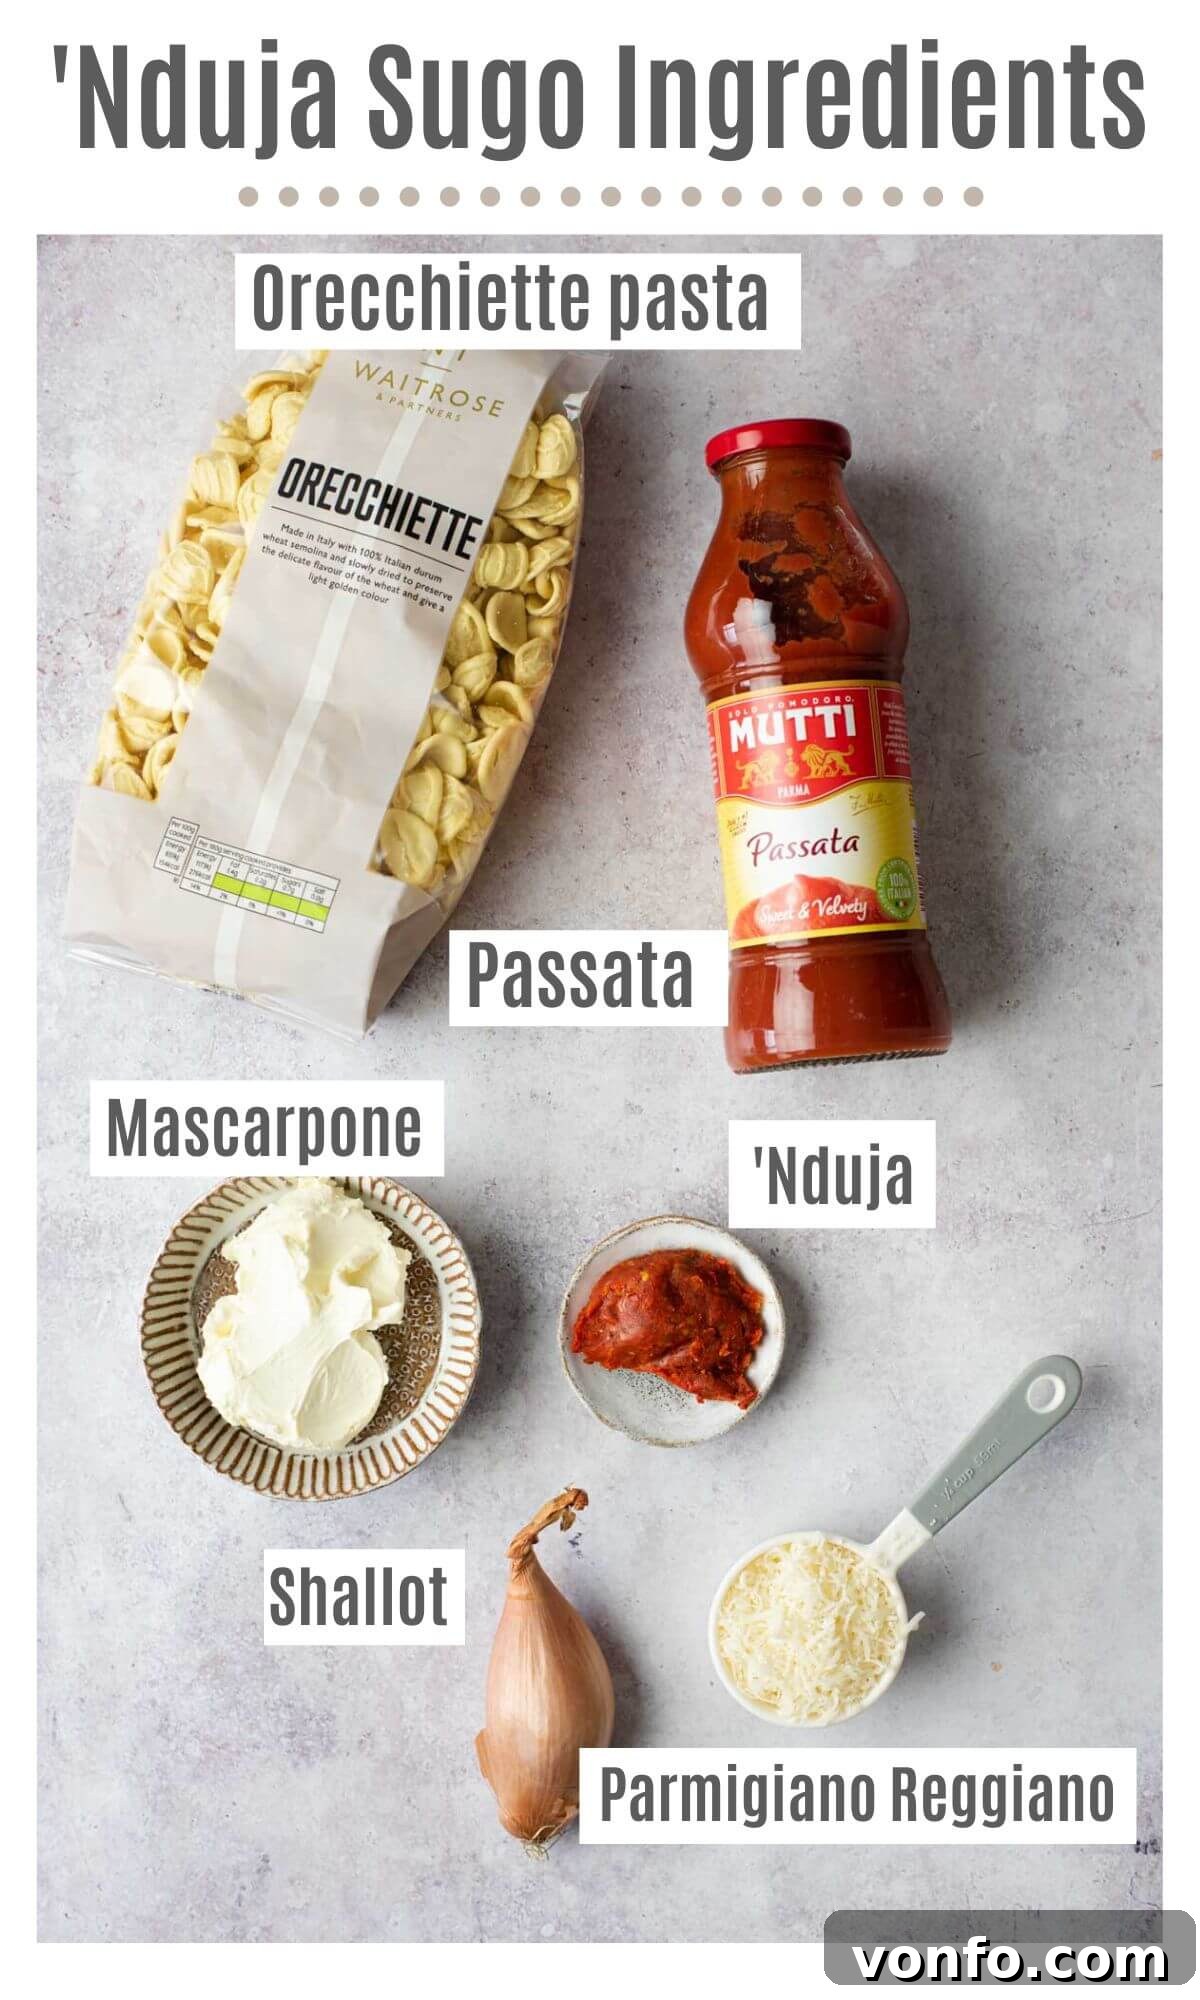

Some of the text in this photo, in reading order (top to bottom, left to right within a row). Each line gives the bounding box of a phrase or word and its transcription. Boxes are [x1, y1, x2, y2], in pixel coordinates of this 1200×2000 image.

[355, 360, 505, 417] WAITROSE
[389, 396, 462, 422] PARTNERS
[277, 457, 483, 560] ORECCHIETTE
[263, 533, 453, 601] wheat semolina and slowly dried to preserve
[281, 523, 442, 583] Made in Italy with 100% Italian durum
[262, 545, 276, 556] the
[278, 550, 311, 566] delicate
[313, 560, 343, 576] flavour
[345, 571, 355, 580] of
[357, 575, 371, 585] the
[374, 580, 400, 594] wheat
[402, 590, 419, 601] and
[419, 597, 438, 609] give
[308, 572, 389, 604] light golden colour
[729, 705, 758, 719] SOLO
[729, 704, 856, 753] MUTTI
[777, 783, 810, 798] PARMA
[164, 842, 185, 853] Energy
[169, 829, 191, 840] cooked
[747, 827, 860, 867] Passata
[196, 851, 216, 862] Energy
[759, 895, 868, 923] Sweet & Velvety
[955, 1467, 975, 1488] cup
